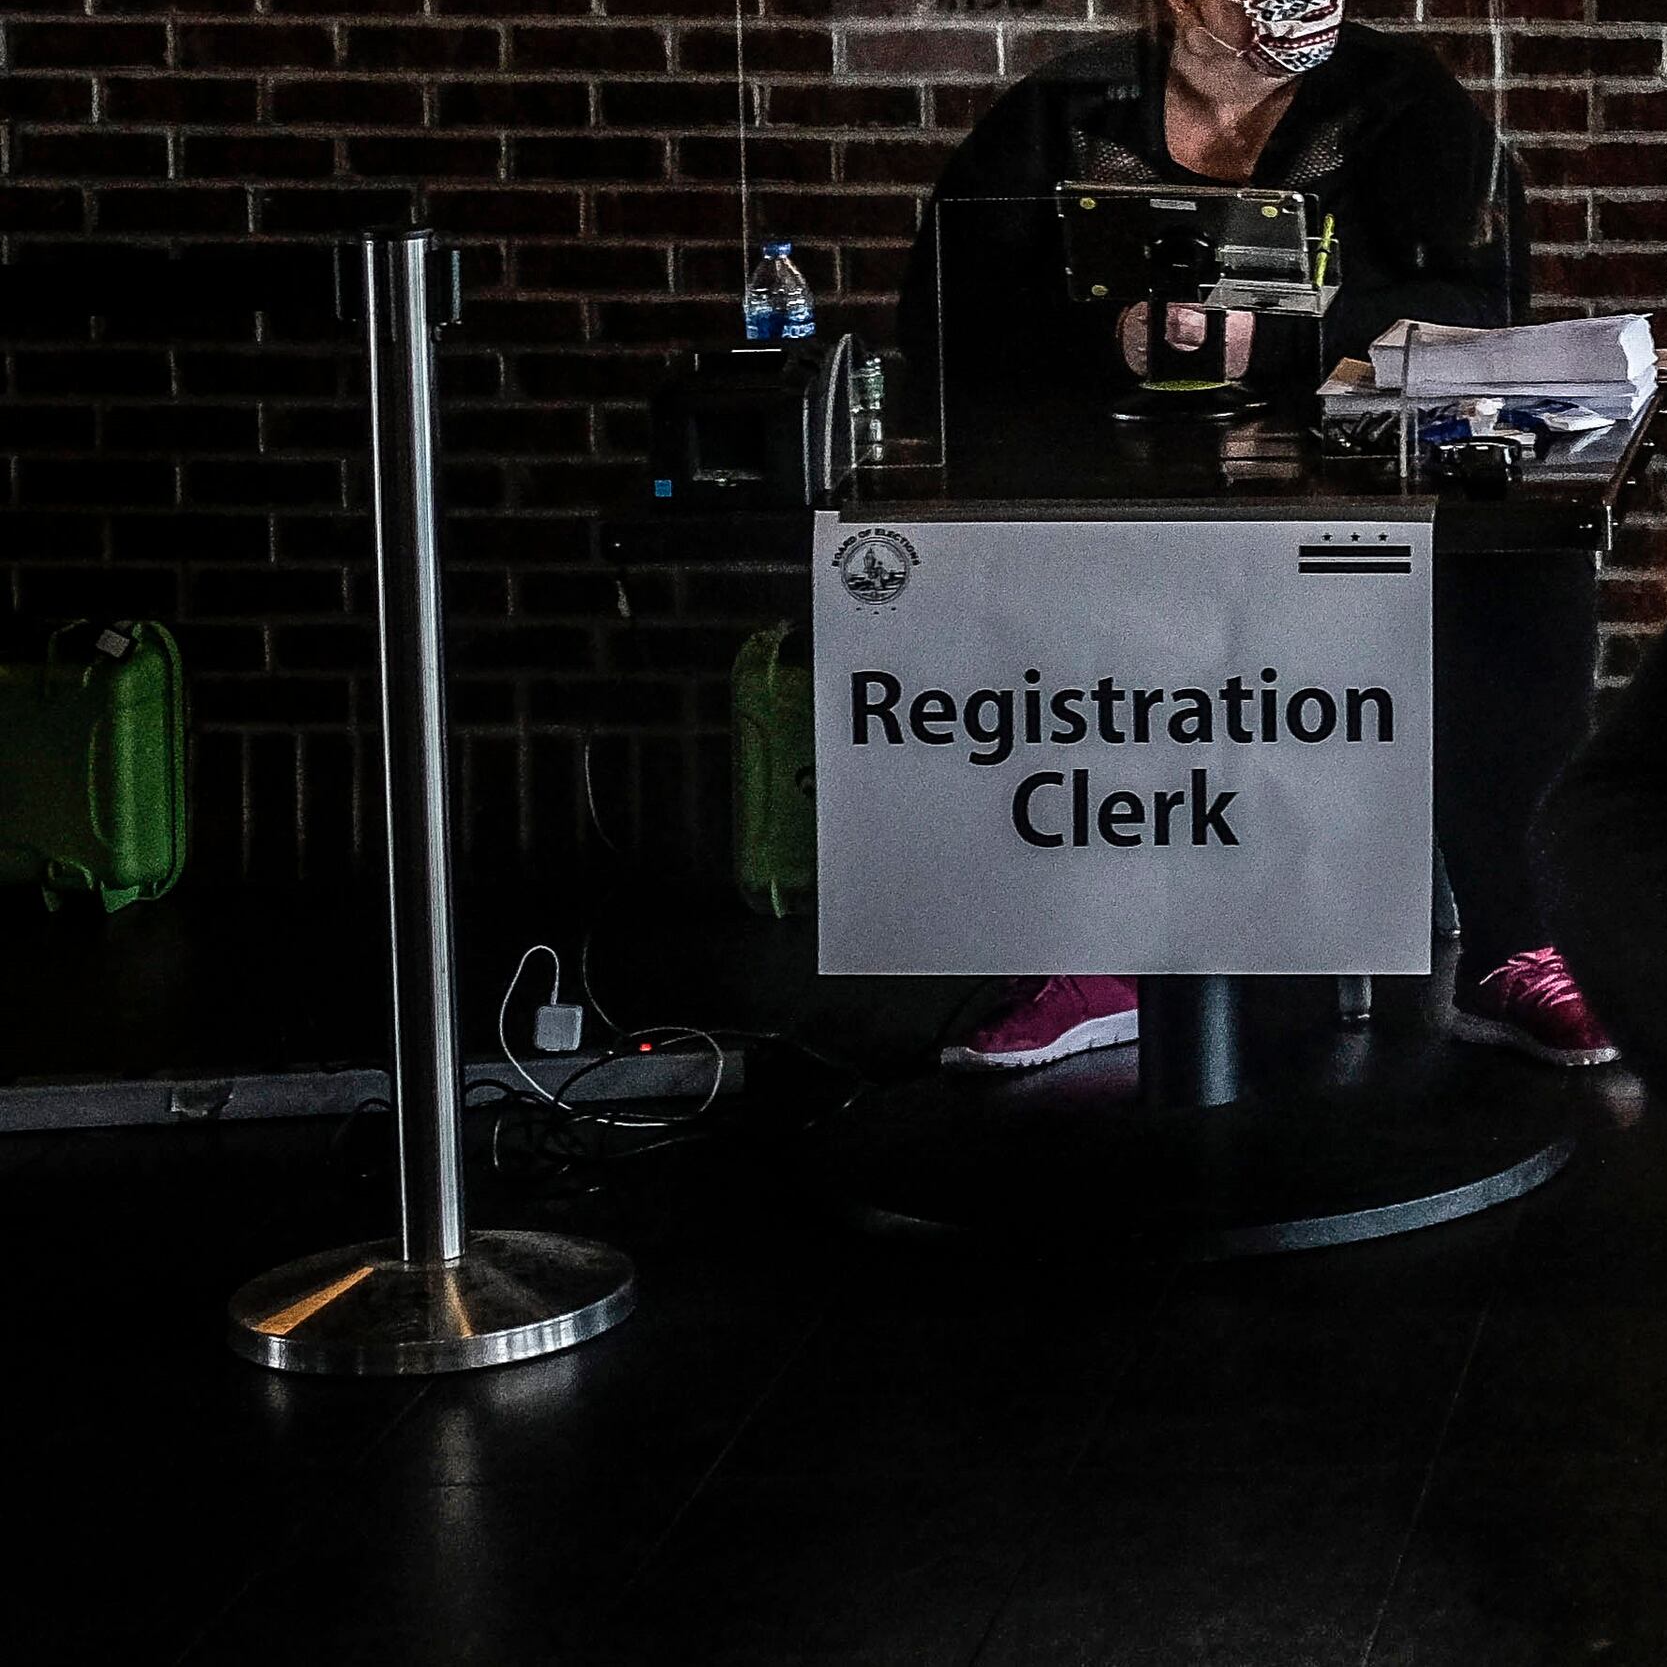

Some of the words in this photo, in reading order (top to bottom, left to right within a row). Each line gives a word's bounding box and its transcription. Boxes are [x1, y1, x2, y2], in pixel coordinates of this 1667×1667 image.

[831, 536, 857, 567] BOARD
[858, 528, 872, 538] OF
[875, 528, 921, 566] ELECTIONS
[851, 667, 1395, 765] Registration
[1012, 768, 1239, 847] Clerk
